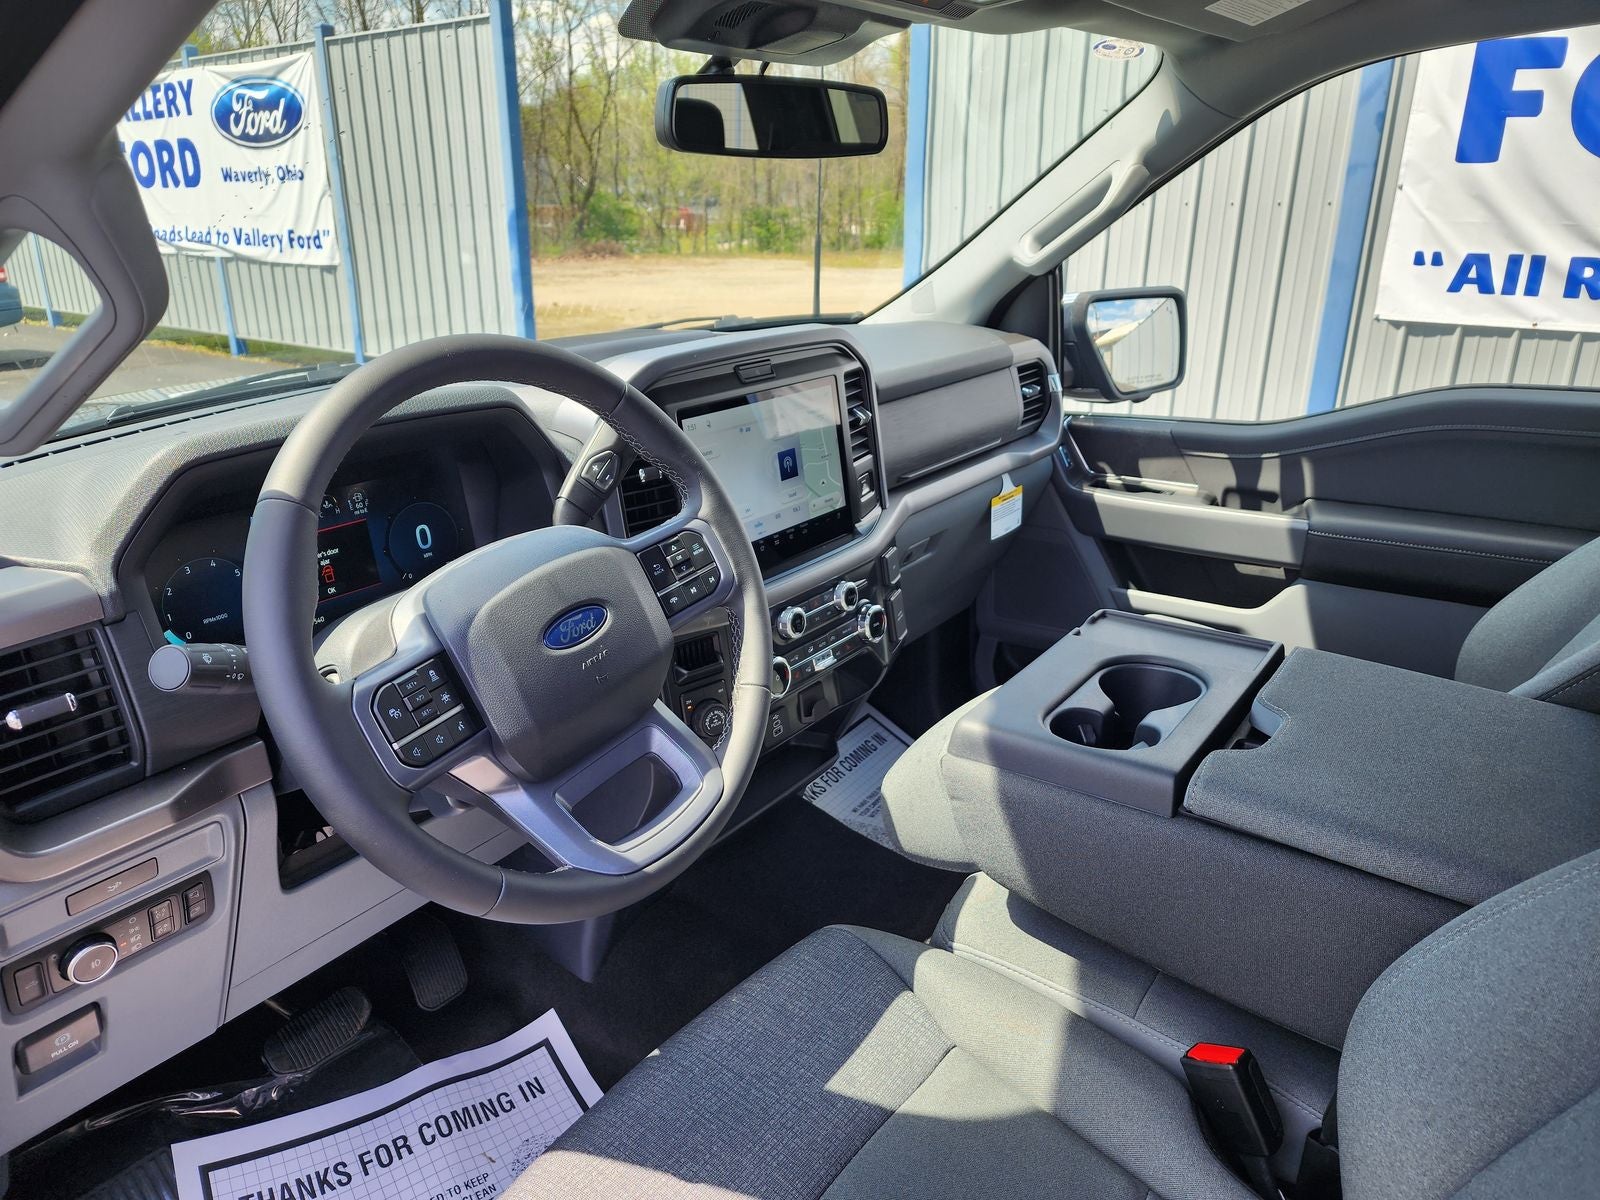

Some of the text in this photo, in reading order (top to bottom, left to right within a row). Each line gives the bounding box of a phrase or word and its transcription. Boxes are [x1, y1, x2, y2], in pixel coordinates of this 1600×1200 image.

[125, 79, 193, 122] LLERY
[229, 88, 287, 137] Ford
[1455, 36, 1600, 163] F
[119, 138, 201, 188] ORD
[220, 164, 304, 186] Waverly, Ohio
[153, 225, 183, 242] oads
[185, 226, 212, 244] Lead
[216, 228, 230, 245] to
[233, 227, 283, 253] Vallery
[415, 524, 432, 549] 0
[184, 566, 191, 574] 3
[234, 568, 241, 577] 5
[166, 587, 173, 596] 2
[327, 586, 337, 594] OK
[185, 631, 192, 640] 0
[559, 613, 597, 643] Ford
[823, 766, 847, 788] FOR
[840, 739, 878, 772] COMING
[870, 731, 888, 746] IN
[51, 1040, 79, 1058] PULL ON
[357, 1134, 414, 1177] FOR
[418, 1092, 516, 1146] COMING
[518, 1076, 546, 1103] IN
[446, 1184, 462, 1198] TO
[464, 1172, 489, 1191] KEEP
